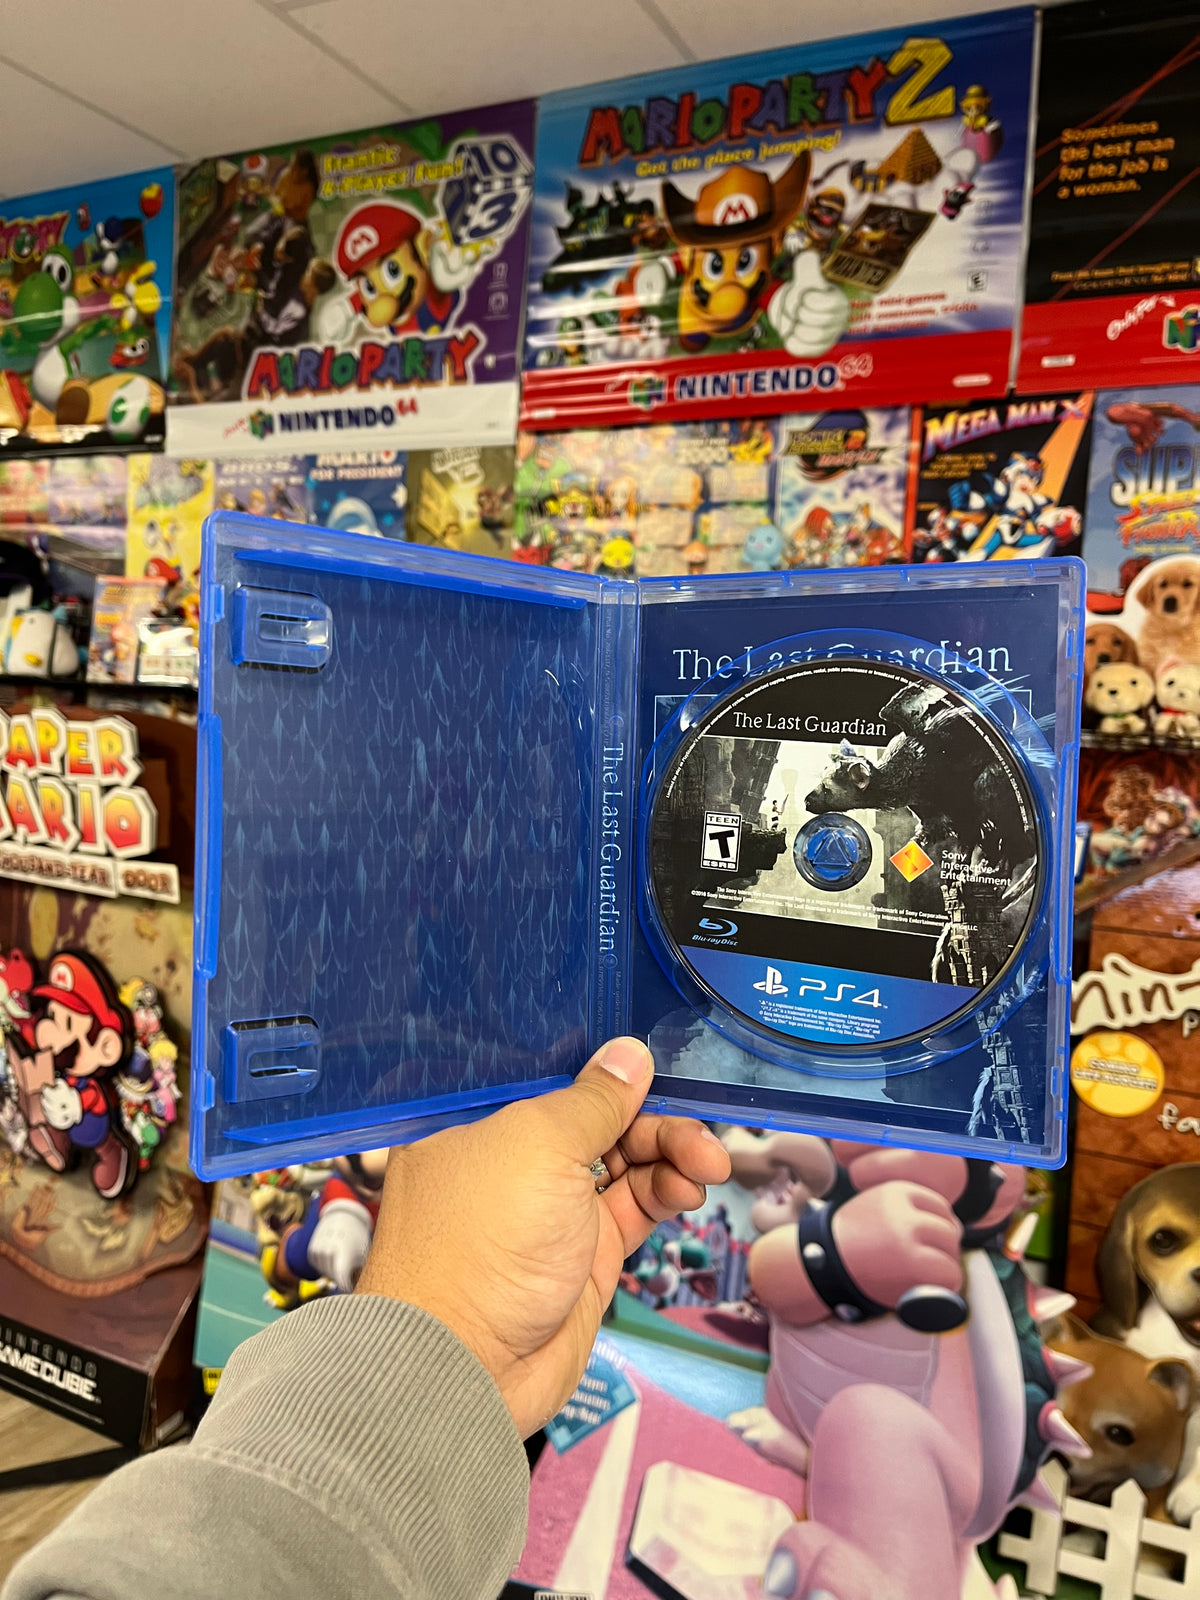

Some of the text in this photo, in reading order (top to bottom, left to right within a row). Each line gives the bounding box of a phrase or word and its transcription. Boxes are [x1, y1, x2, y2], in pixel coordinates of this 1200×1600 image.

[579, 37, 956, 167] MARIO PARTY 2
[1061, 120, 1159, 144] Sometimes
[1060, 136, 1175, 163] the best man
[1058, 155, 1170, 182] for the job is
[1056, 185, 1071, 199] a
[247, 329, 480, 398] MARIO PARTY
[677, 363, 839, 401] NINTENDO
[279, 405, 396, 432] NINTENDO
[923, 407, 1002, 461] MEGA
[1111, 445, 1200, 507] SUP
[673, 647, 735, 682] The
[733, 711, 887, 738] The Last Guardian
[0, 712, 138, 783] APER
[602, 742, 624, 785] The
[0, 777, 153, 853] ARIO
[601, 789, 624, 840] Last
[707, 814, 740, 826] TEEN
[708, 829, 736, 859] T
[941, 849, 968, 863] Sony
[702, 859, 737, 870] ESRB
[939, 870, 1012, 887] Entertainment
[940, 860, 994, 876] Interactive
[599, 843, 624, 955] Guardian
[800, 977, 882, 1008] PS4
[0, 1326, 97, 1379] INTENDO
[0, 1341, 97, 1401] AMECUBE
